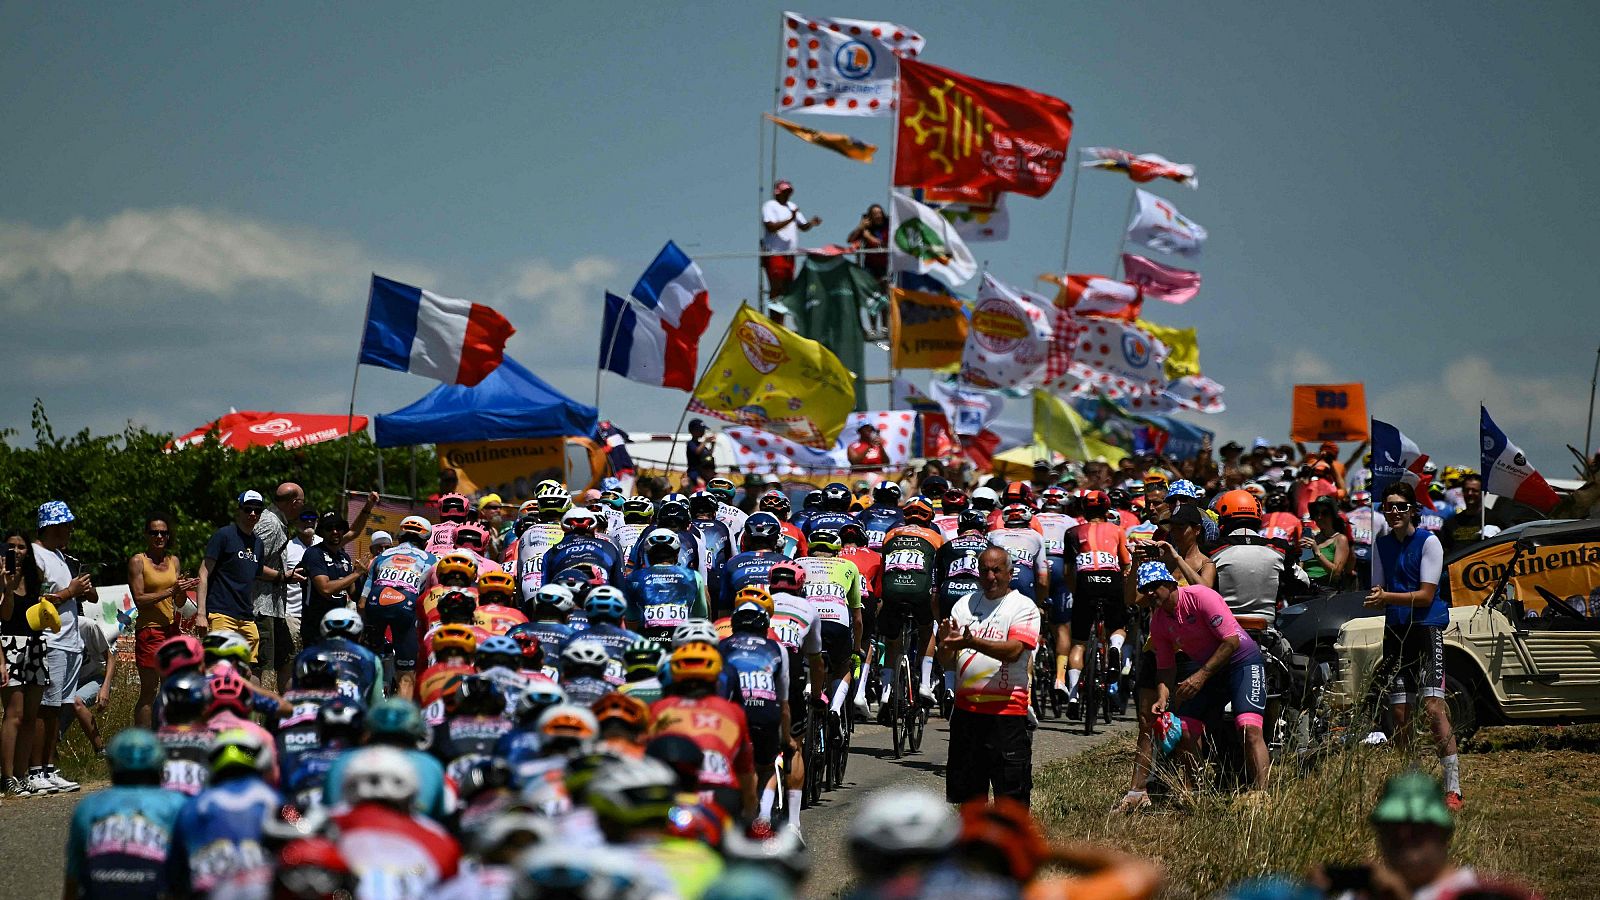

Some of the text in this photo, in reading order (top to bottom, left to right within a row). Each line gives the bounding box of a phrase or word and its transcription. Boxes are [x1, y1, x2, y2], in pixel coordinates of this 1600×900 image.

[565, 544, 584, 555] FDJ
[889, 552, 919, 564] 27 27
[1078, 552, 1114, 565] 35 35
[737, 560, 777, 568] Groupam
[1462, 544, 1600, 591] Coninenta
[744, 566, 764, 574] FDJ
[1088, 575, 1112, 583] INEOS
[948, 581, 978, 589] BORA
[647, 606, 686, 619] 56 56
